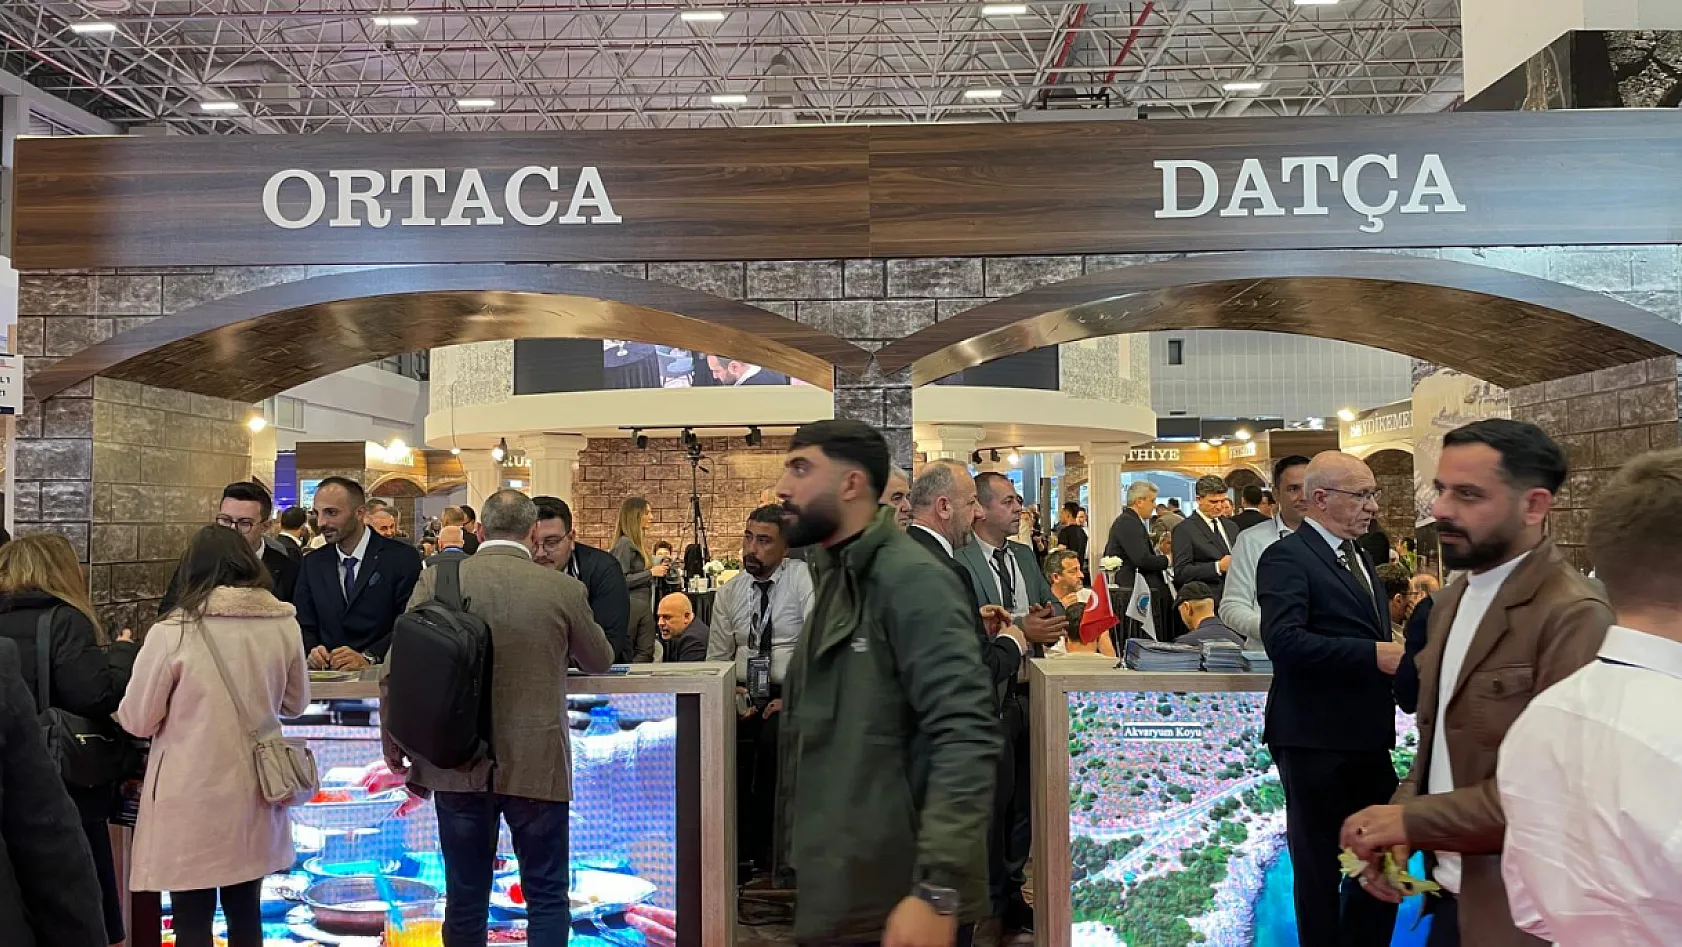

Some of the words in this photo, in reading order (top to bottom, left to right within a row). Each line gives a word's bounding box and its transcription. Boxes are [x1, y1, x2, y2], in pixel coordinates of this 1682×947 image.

[262, 165, 622, 230] ORTACA
[1154, 154, 1467, 233] DATÇA
[1125, 445, 1180, 462] THİYE
[1124, 727, 1174, 738] Akvaryum
[1176, 727, 1202, 738] Koyu
